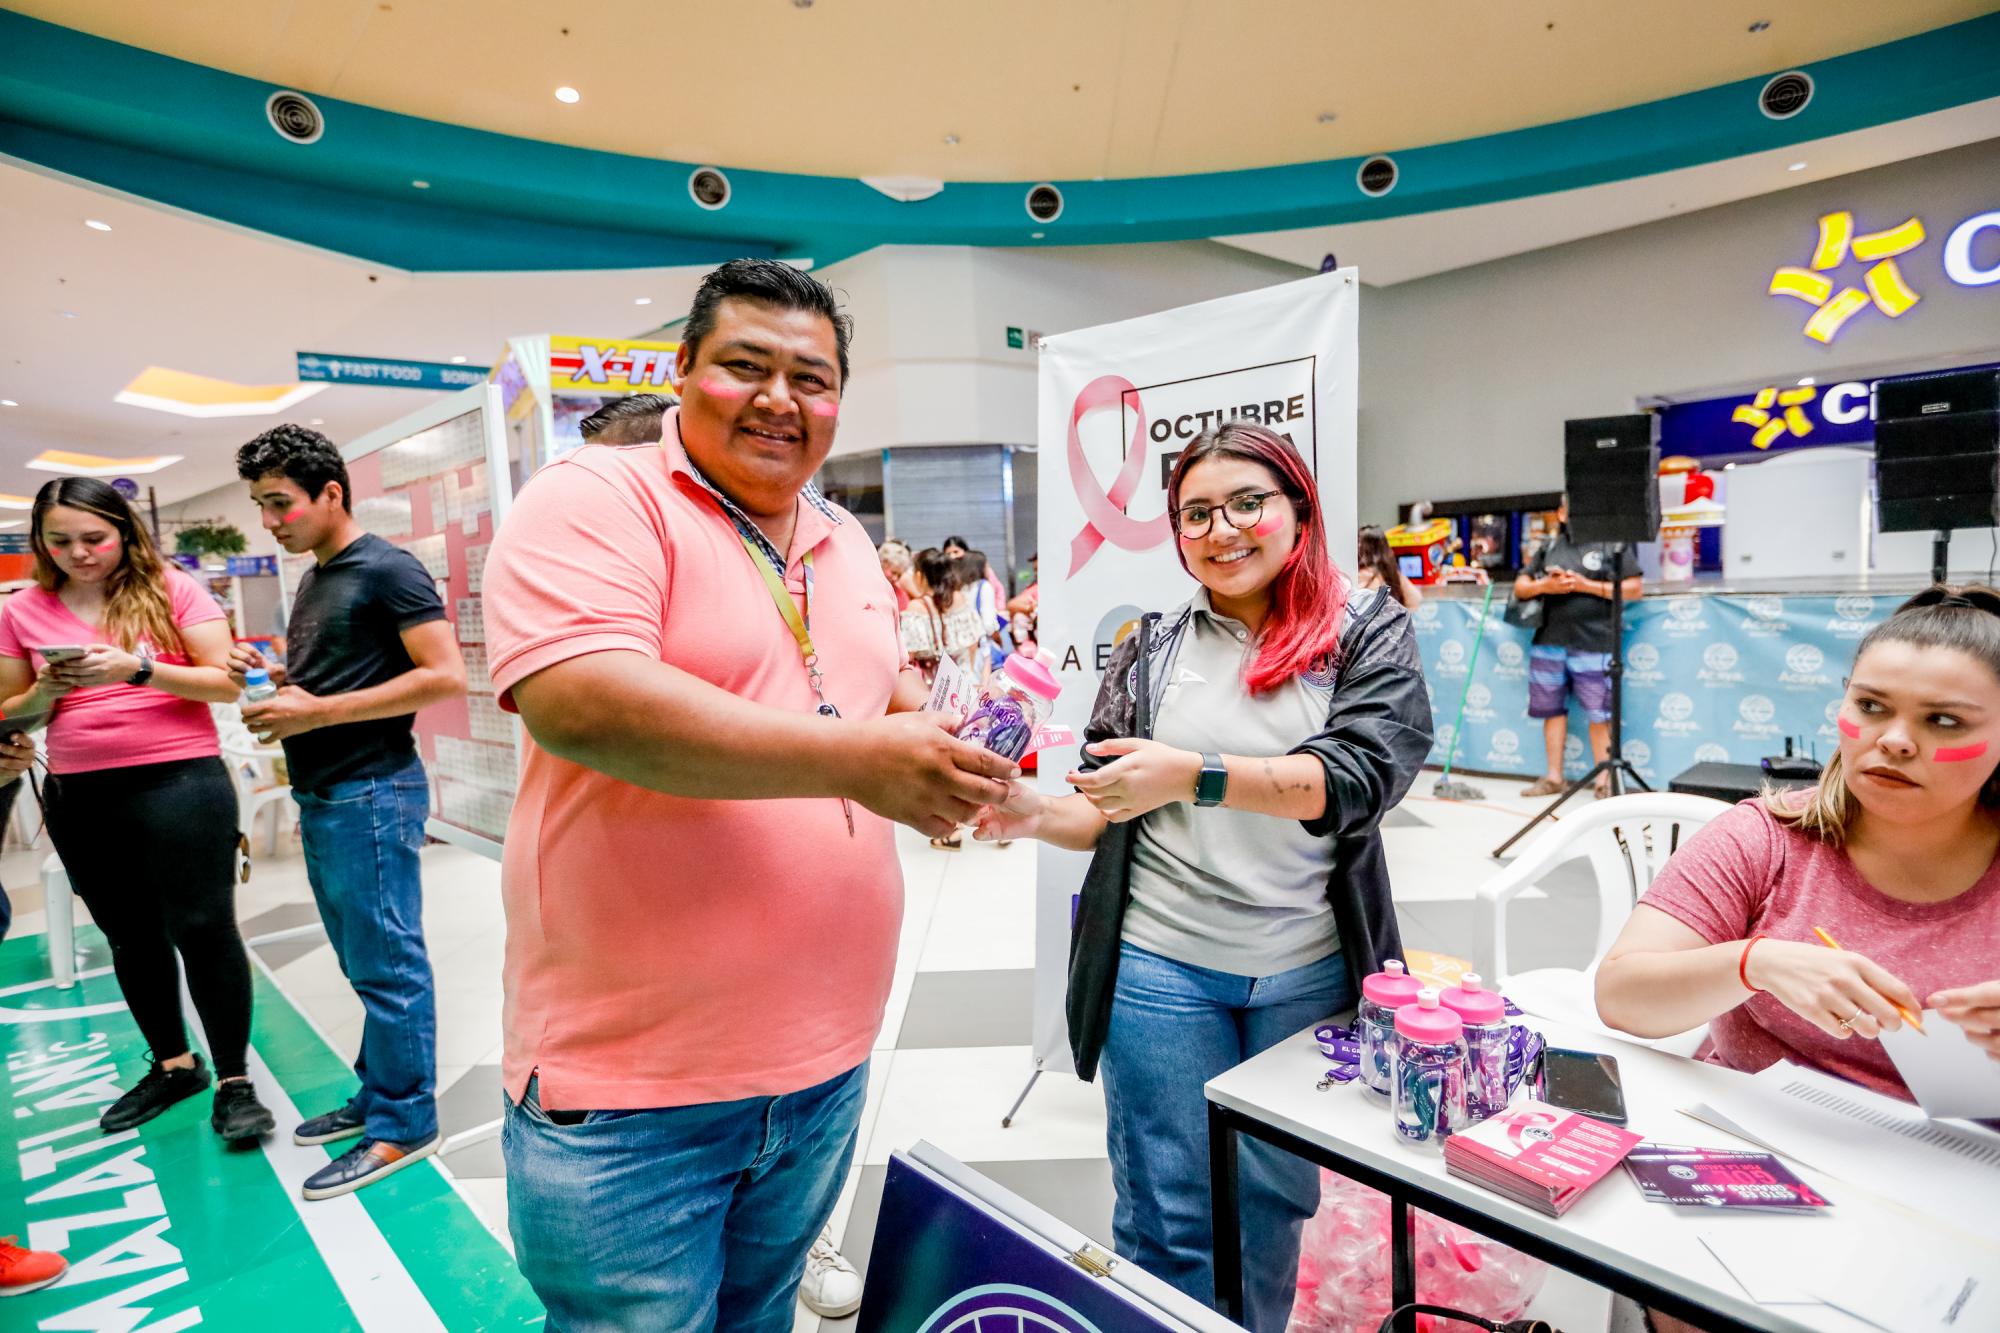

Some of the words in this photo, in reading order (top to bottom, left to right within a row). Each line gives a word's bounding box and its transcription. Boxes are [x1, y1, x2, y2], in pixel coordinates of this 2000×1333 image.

[342, 362, 379, 378] FAST
[382, 365, 422, 381] FOOD
[1150, 394, 1304, 442] OCTUBRE
